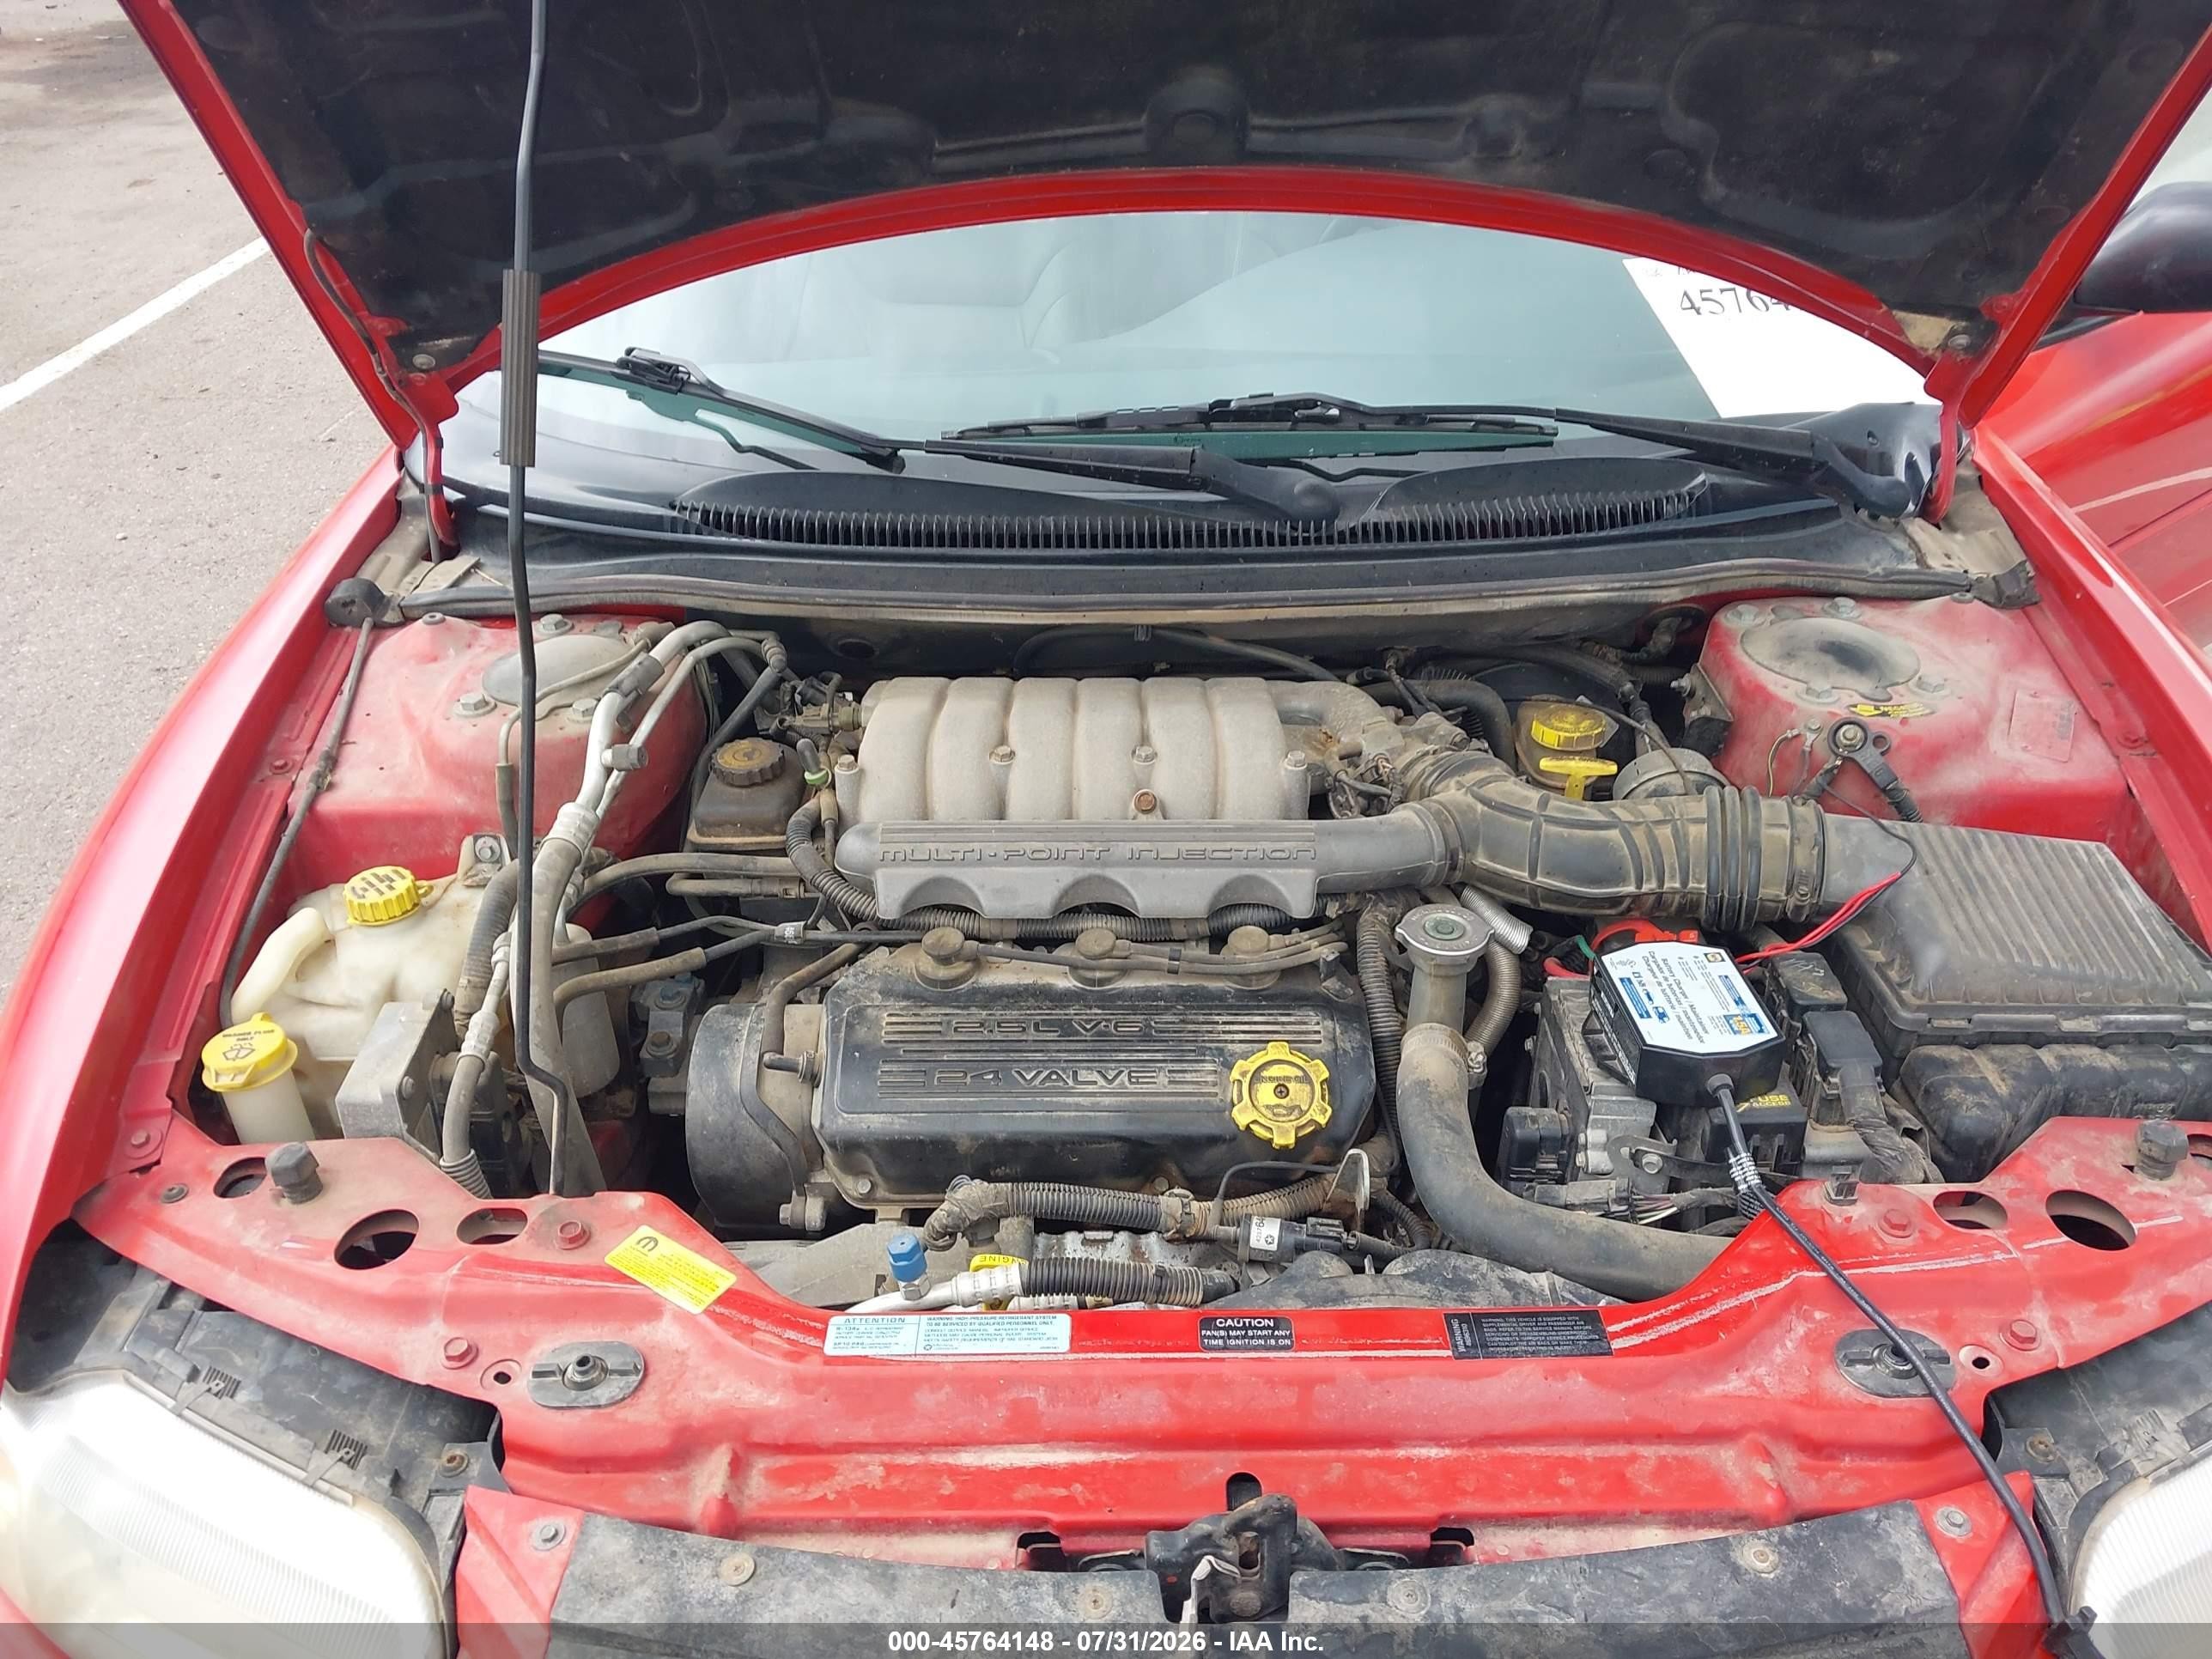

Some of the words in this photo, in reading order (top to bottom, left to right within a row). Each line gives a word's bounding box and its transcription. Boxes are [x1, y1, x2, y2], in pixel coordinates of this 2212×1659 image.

[1127, 847, 1317, 861] INJECTION
[933, 1069, 1003, 1086] 24
[1012, 1068, 1159, 1086] VALVE
[1216, 1318, 1274, 1328] CAUTION
[1450, 1318, 1467, 1352] WARNING
